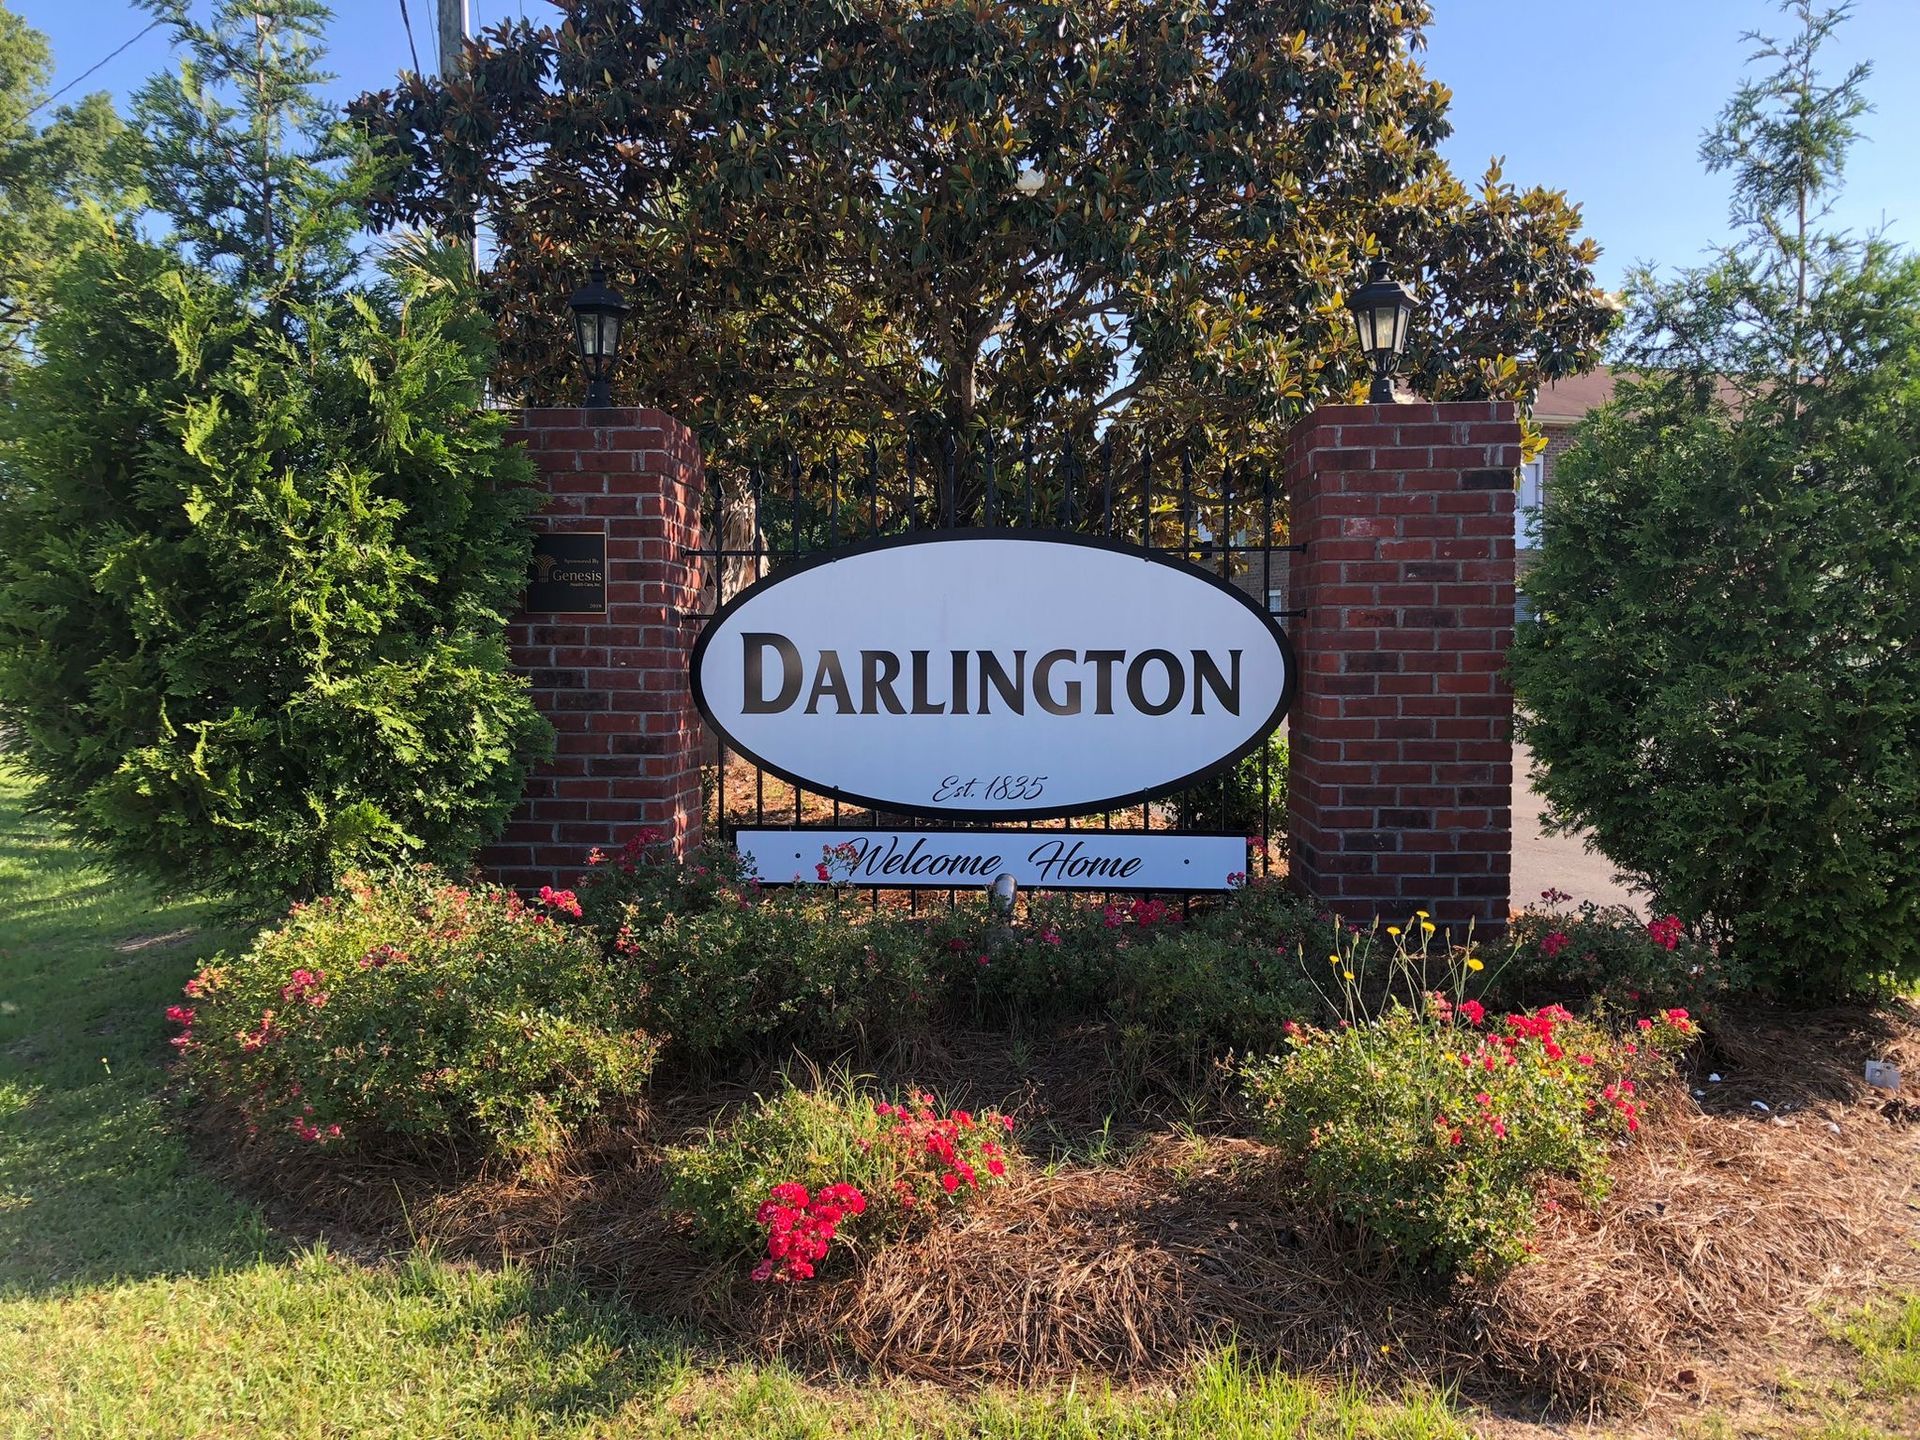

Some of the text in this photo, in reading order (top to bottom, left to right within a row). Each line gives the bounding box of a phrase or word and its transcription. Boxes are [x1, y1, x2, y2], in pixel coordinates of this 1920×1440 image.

[552, 569, 602, 581] Genesis
[740, 631, 1242, 717] DARLINGTON
[932, 775, 1048, 802] Est. 1835
[848, 835, 1145, 883] Welcome Home
